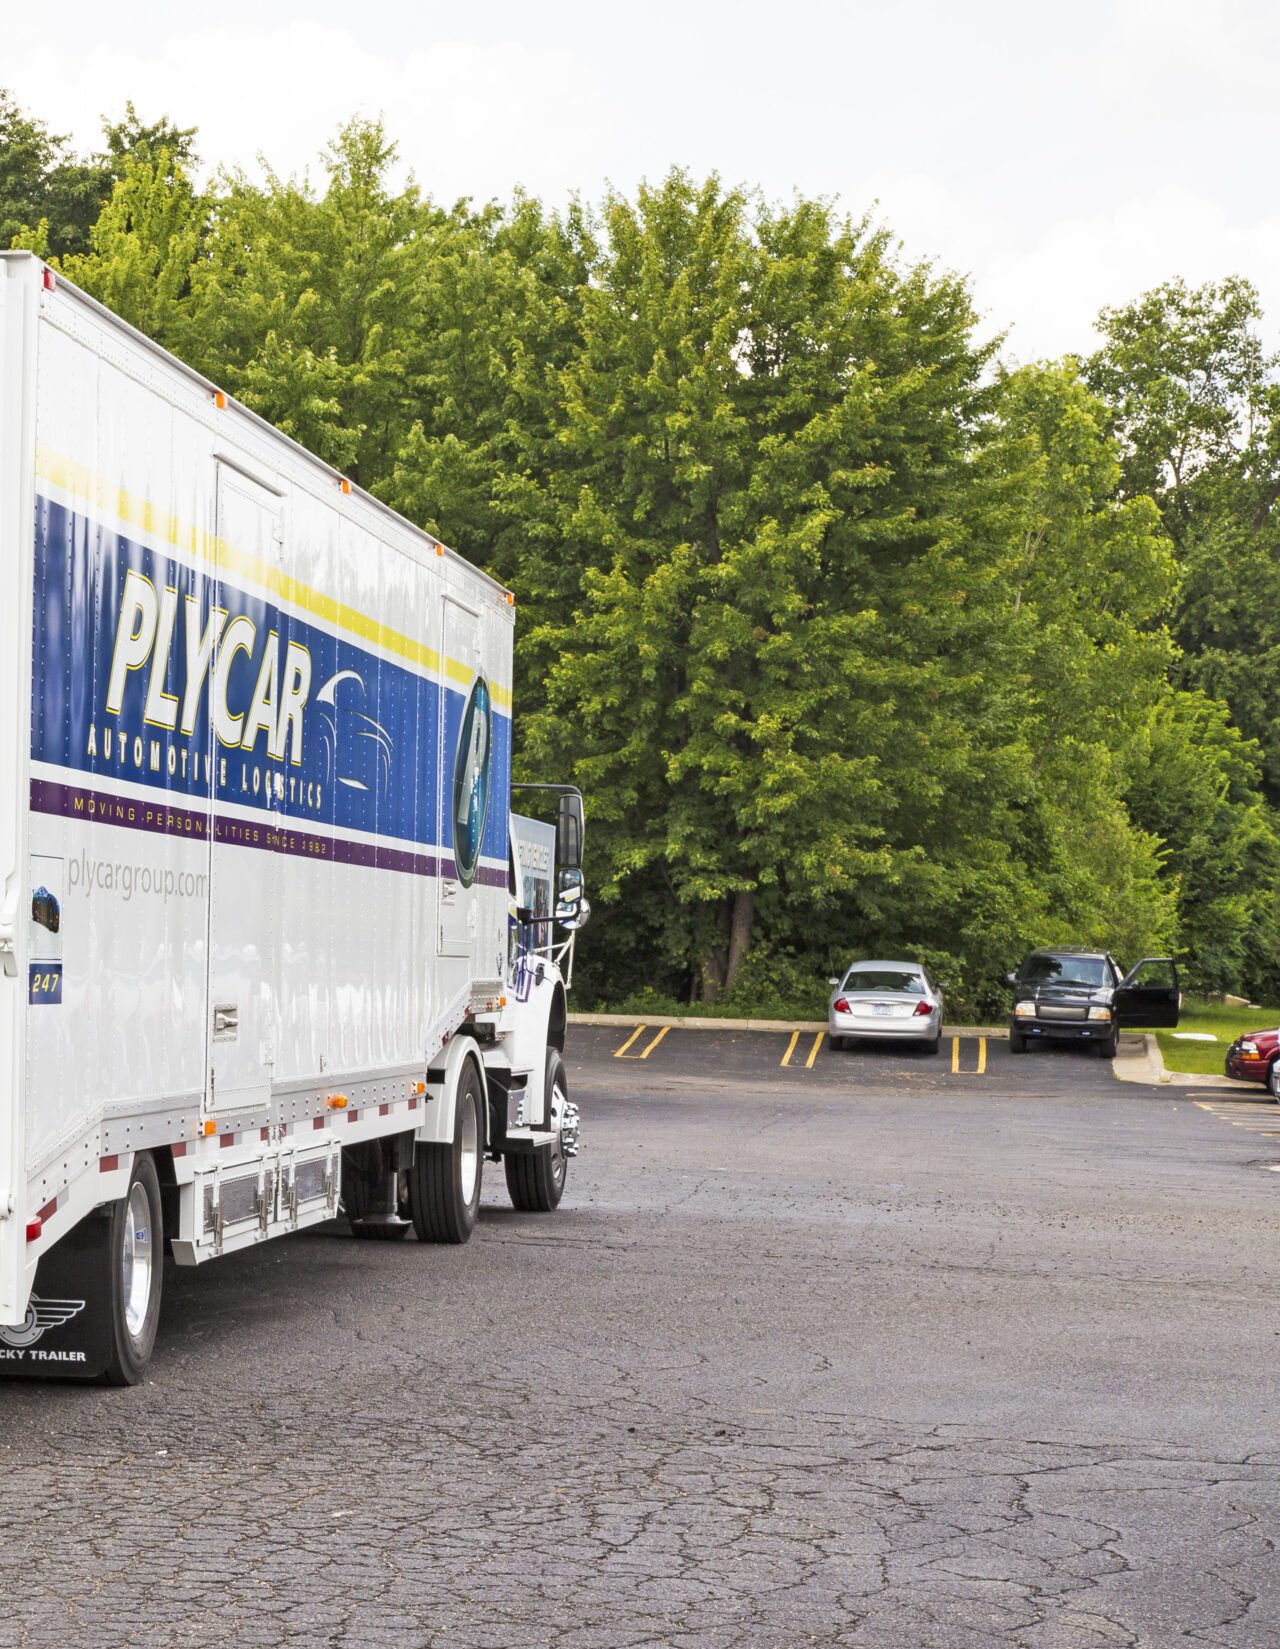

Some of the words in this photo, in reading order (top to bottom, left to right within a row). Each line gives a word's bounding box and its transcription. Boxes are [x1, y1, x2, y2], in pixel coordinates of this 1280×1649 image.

[105, 568, 312, 766] PLYCAR
[87, 723, 227, 787] AUTOMOTIVE
[242, 763, 322, 810] LOGSTICS
[74, 797, 135, 821] MOVING
[146, 811, 259, 842] PERSONALITIES
[68, 847, 208, 904] plycargroup.com
[32, 973, 59, 992] 247
[29, 1350, 87, 1362] TRAILER
